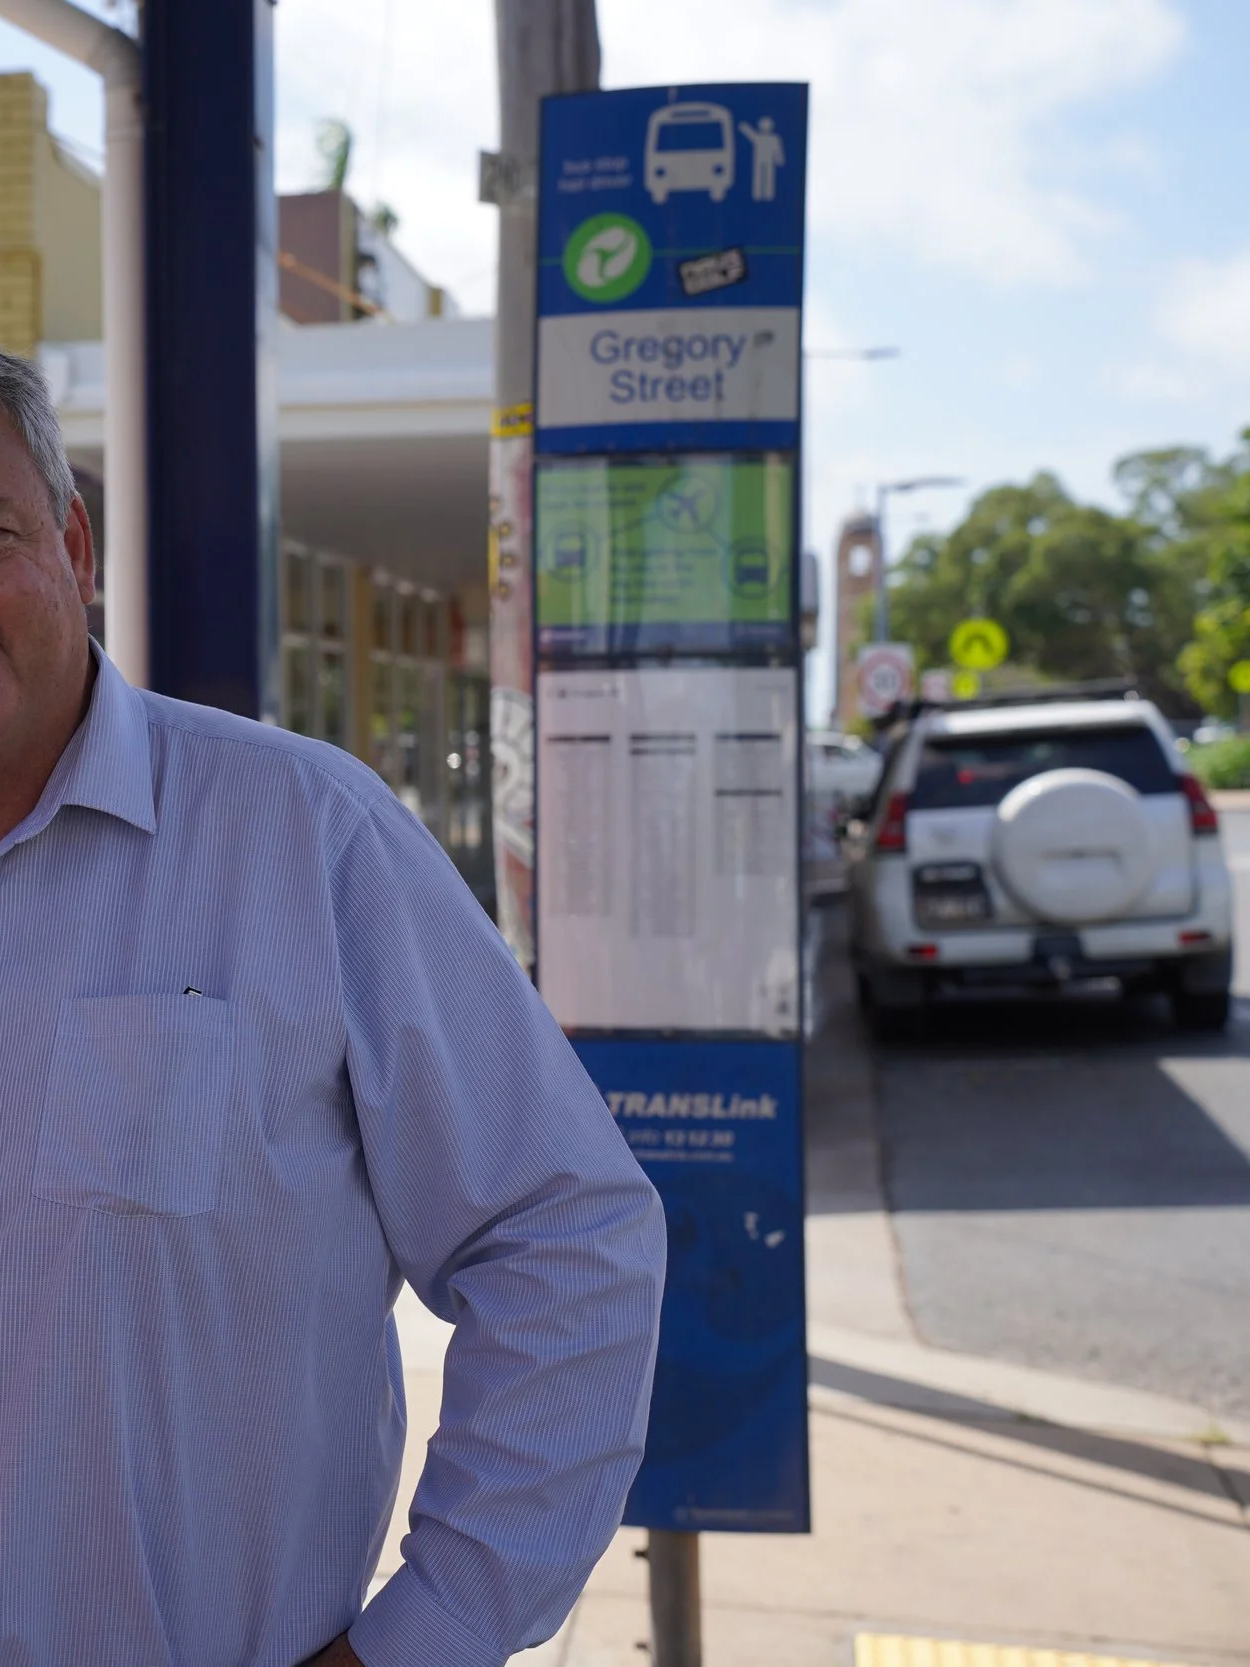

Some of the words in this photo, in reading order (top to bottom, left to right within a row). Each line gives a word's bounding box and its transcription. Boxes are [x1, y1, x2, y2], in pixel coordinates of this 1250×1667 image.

[590, 328, 746, 369] Gregory
[609, 369, 725, 404] Street
[605, 1091, 778, 1119] TRANSLink
